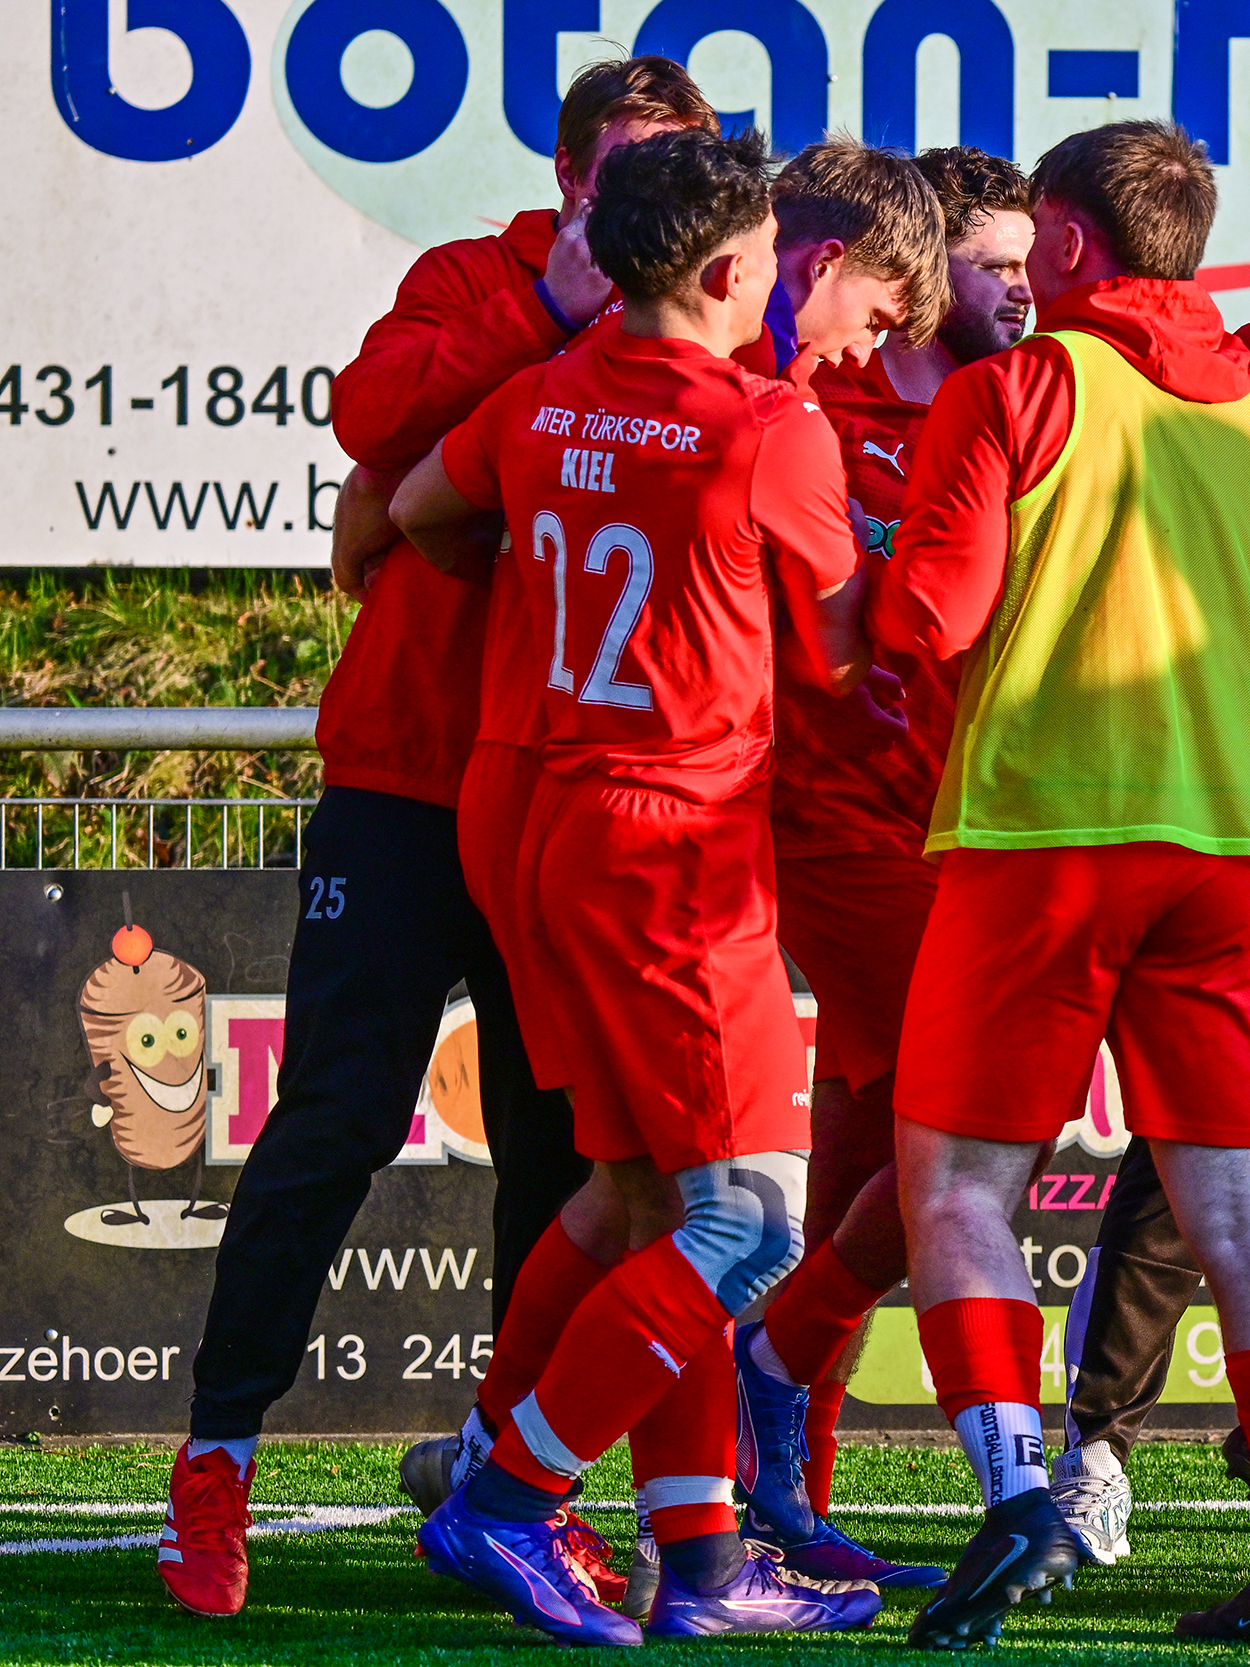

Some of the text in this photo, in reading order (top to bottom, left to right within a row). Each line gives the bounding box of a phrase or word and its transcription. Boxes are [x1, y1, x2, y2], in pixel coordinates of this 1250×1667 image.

[581, 408, 700, 452] TÜRKSPOR
[561, 448, 616, 493] KIEL
[532, 510, 654, 712] 22
[305, 876, 347, 919] 25
[0, 1335, 181, 1382] zehoer
